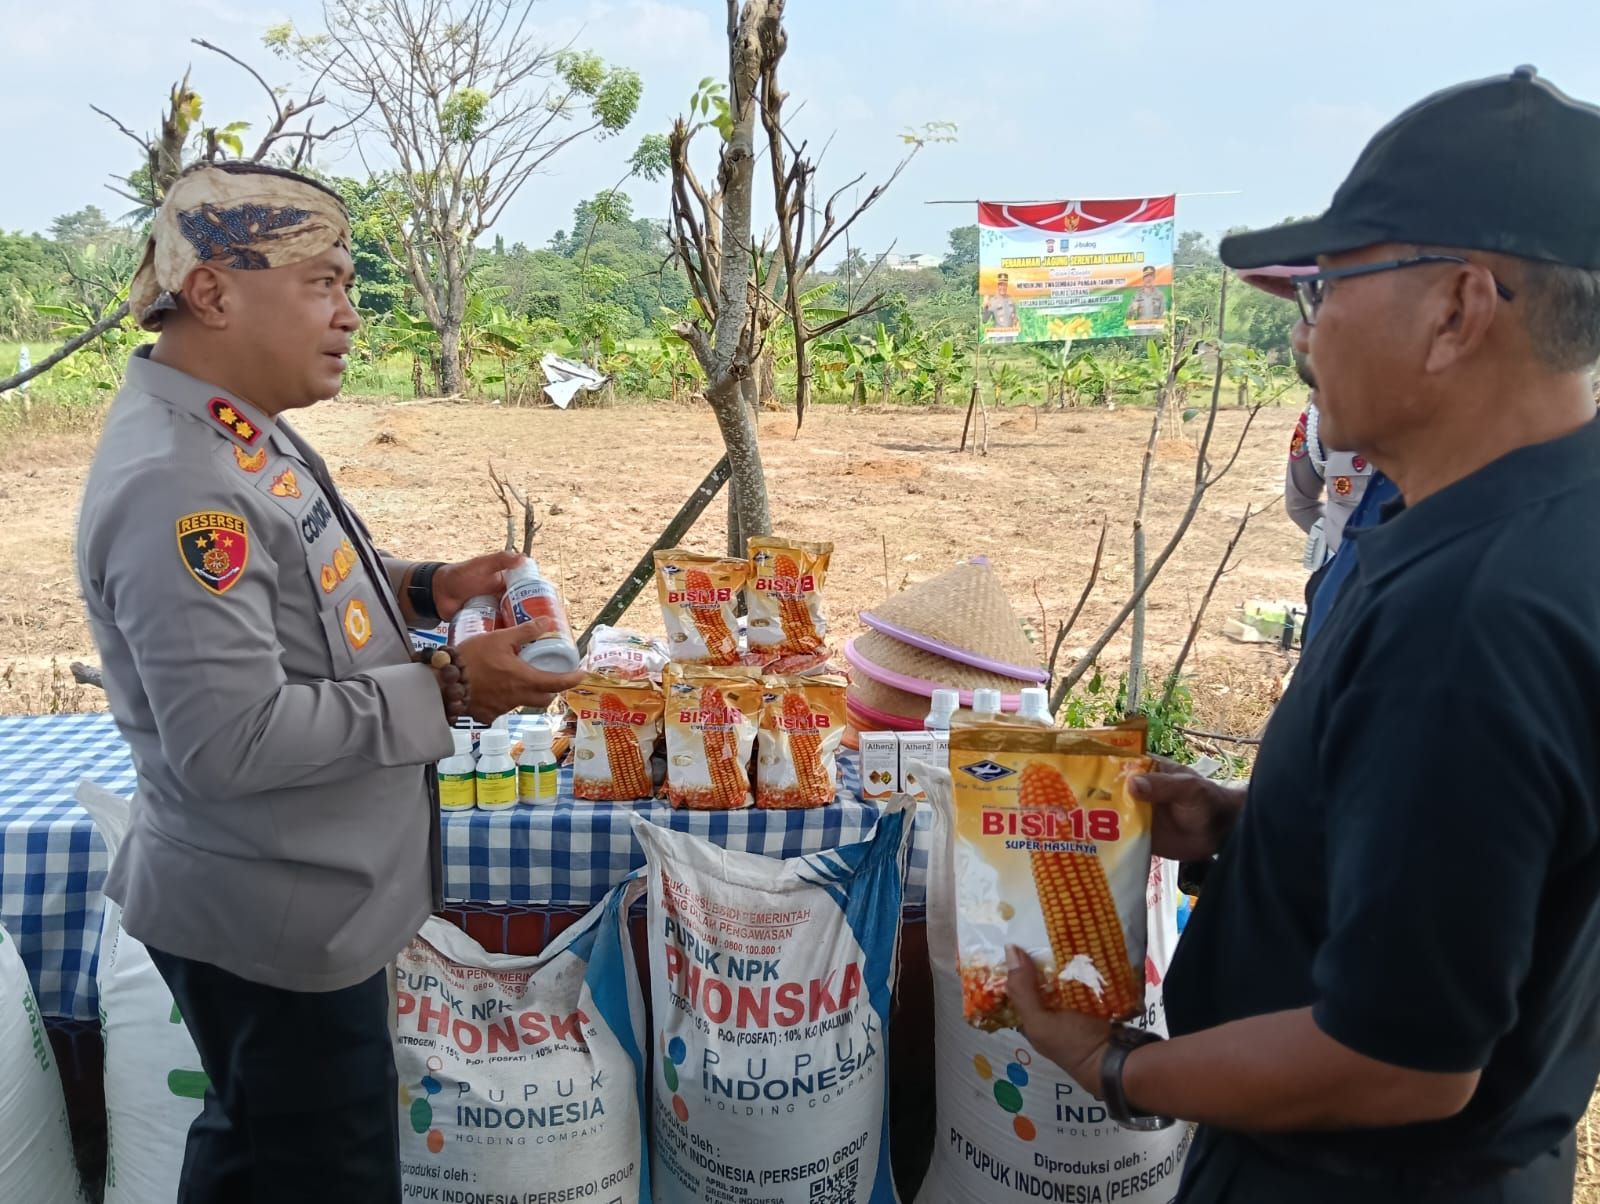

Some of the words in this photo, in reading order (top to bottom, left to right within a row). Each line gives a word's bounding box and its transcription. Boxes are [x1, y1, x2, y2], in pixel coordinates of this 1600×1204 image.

[181, 514, 244, 533] RESERSE
[668, 590, 704, 604] BISI
[709, 588, 732, 602] 18
[627, 651, 644, 662] 18
[622, 711, 647, 726] 18
[806, 713, 831, 728] 18
[982, 811, 1056, 838] BISI
[1069, 807, 1121, 842] 18
[1005, 840, 1041, 850] SUPER
[1043, 841, 1097, 853] HASILNYA
[719, 922, 793, 941] PENGAWASAN
[665, 916, 720, 975] PUPUK
[727, 956, 780, 982] NPK
[396, 968, 464, 1016] PUPUK
[665, 943, 862, 1029] PHONSKA
[737, 1032, 777, 1047] (FOSFAT)
[784, 1029, 802, 1042] 10%
[819, 1010, 853, 1037] (KALIUM)
[488, 1055, 527, 1063] (FOSFAT)
[536, 1044, 553, 1058] 10%
[702, 1042, 877, 1101] INDONESIA
[457, 1097, 605, 1130] INDONESIA
[704, 1095, 795, 1117] HOLDING
[455, 1133, 526, 1146] HOLDING
[536, 1124, 605, 1145] COMPANY
[1056, 1126, 1121, 1137] HOLDIN
[690, 1134, 713, 1155] oleh
[689, 1147, 756, 1184] INDONESIA
[759, 1157, 830, 1188] (PERSERO)
[833, 1131, 869, 1166] GROUP
[950, 1127, 962, 1154] PT
[965, 1141, 1010, 1188] PUPUK
[1015, 1173, 1102, 1204] INDONESIA
[1106, 1149, 1175, 1204] (PERSERO)
[1034, 1152, 1110, 1175] Diproduksi
[1114, 1152, 1140, 1171] oleh
[404, 1183, 439, 1201] PUPUK
[442, 1189, 518, 1204] INDONESIA
[523, 1180, 598, 1204] (PERSERO)
[601, 1162, 635, 1190] GROUP
[443, 1163, 468, 1182] oleh
